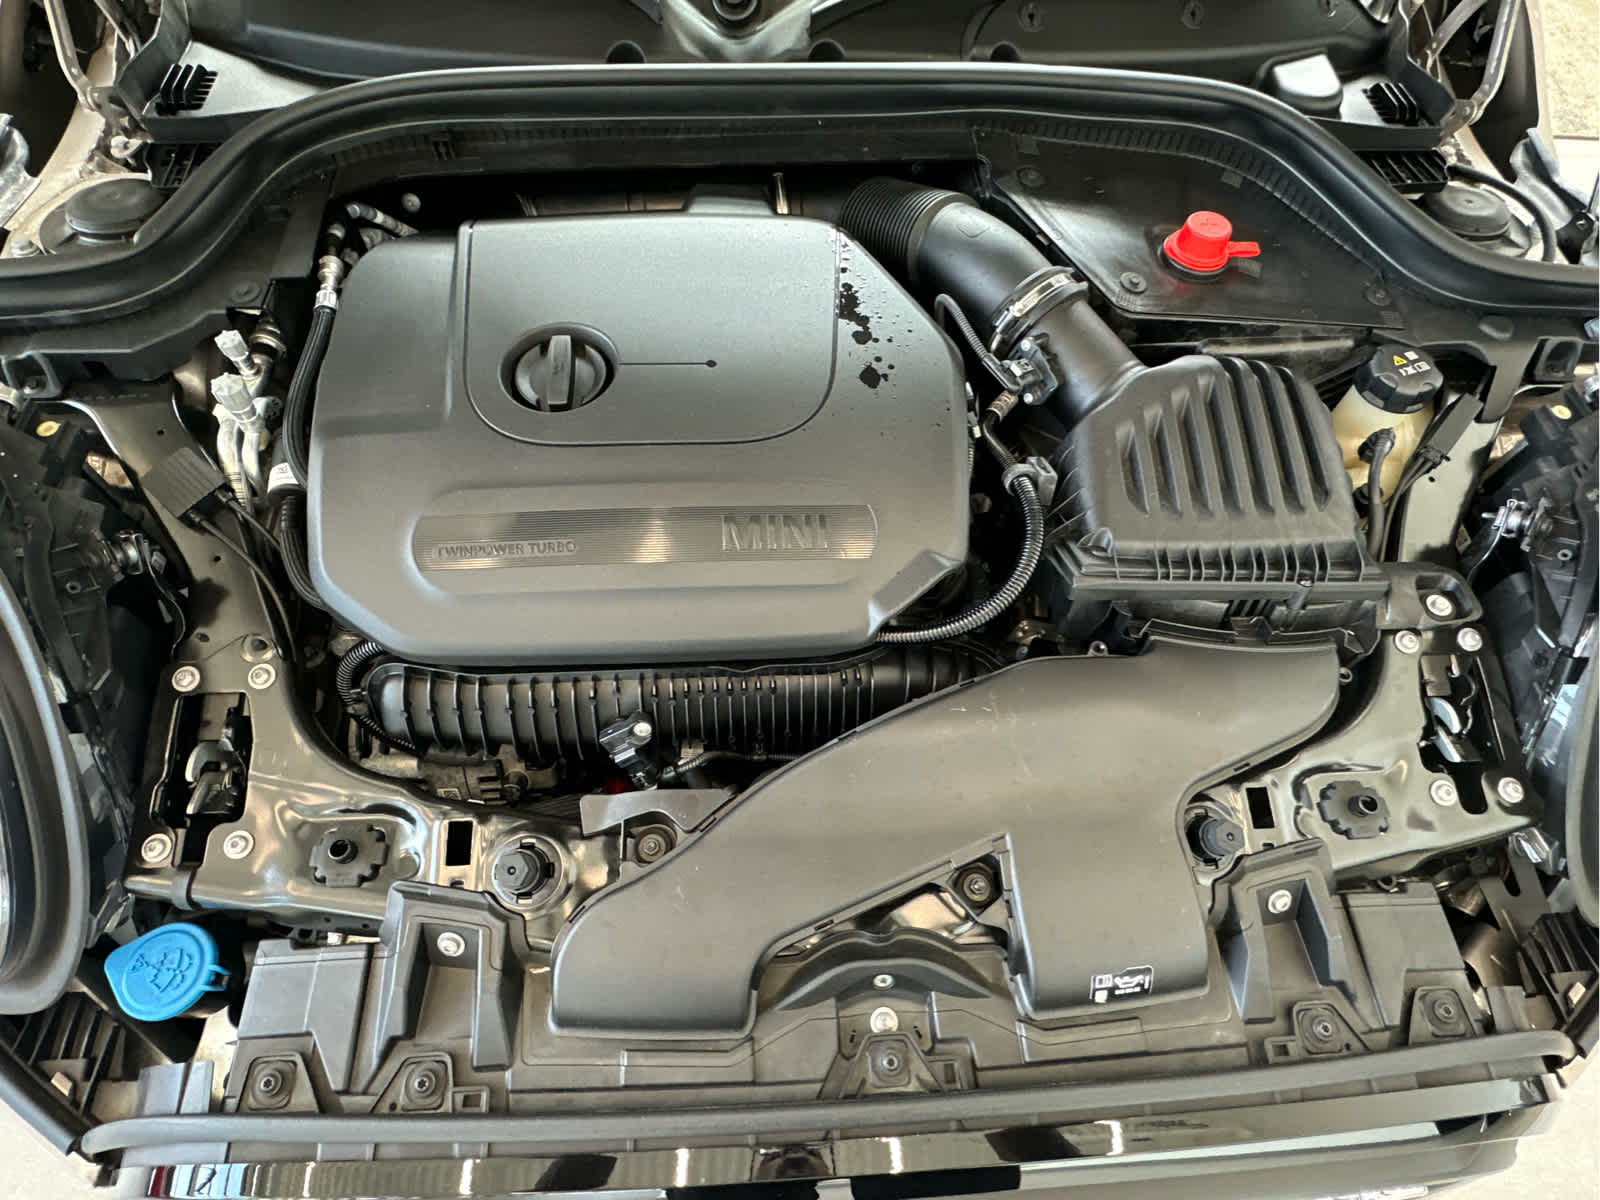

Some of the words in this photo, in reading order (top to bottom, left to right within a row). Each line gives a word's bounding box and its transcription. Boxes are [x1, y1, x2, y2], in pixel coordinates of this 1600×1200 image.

[720, 513, 829, 552] MINI
[437, 543, 526, 558] TWINPOWER
[528, 541, 577, 555] TURBO
